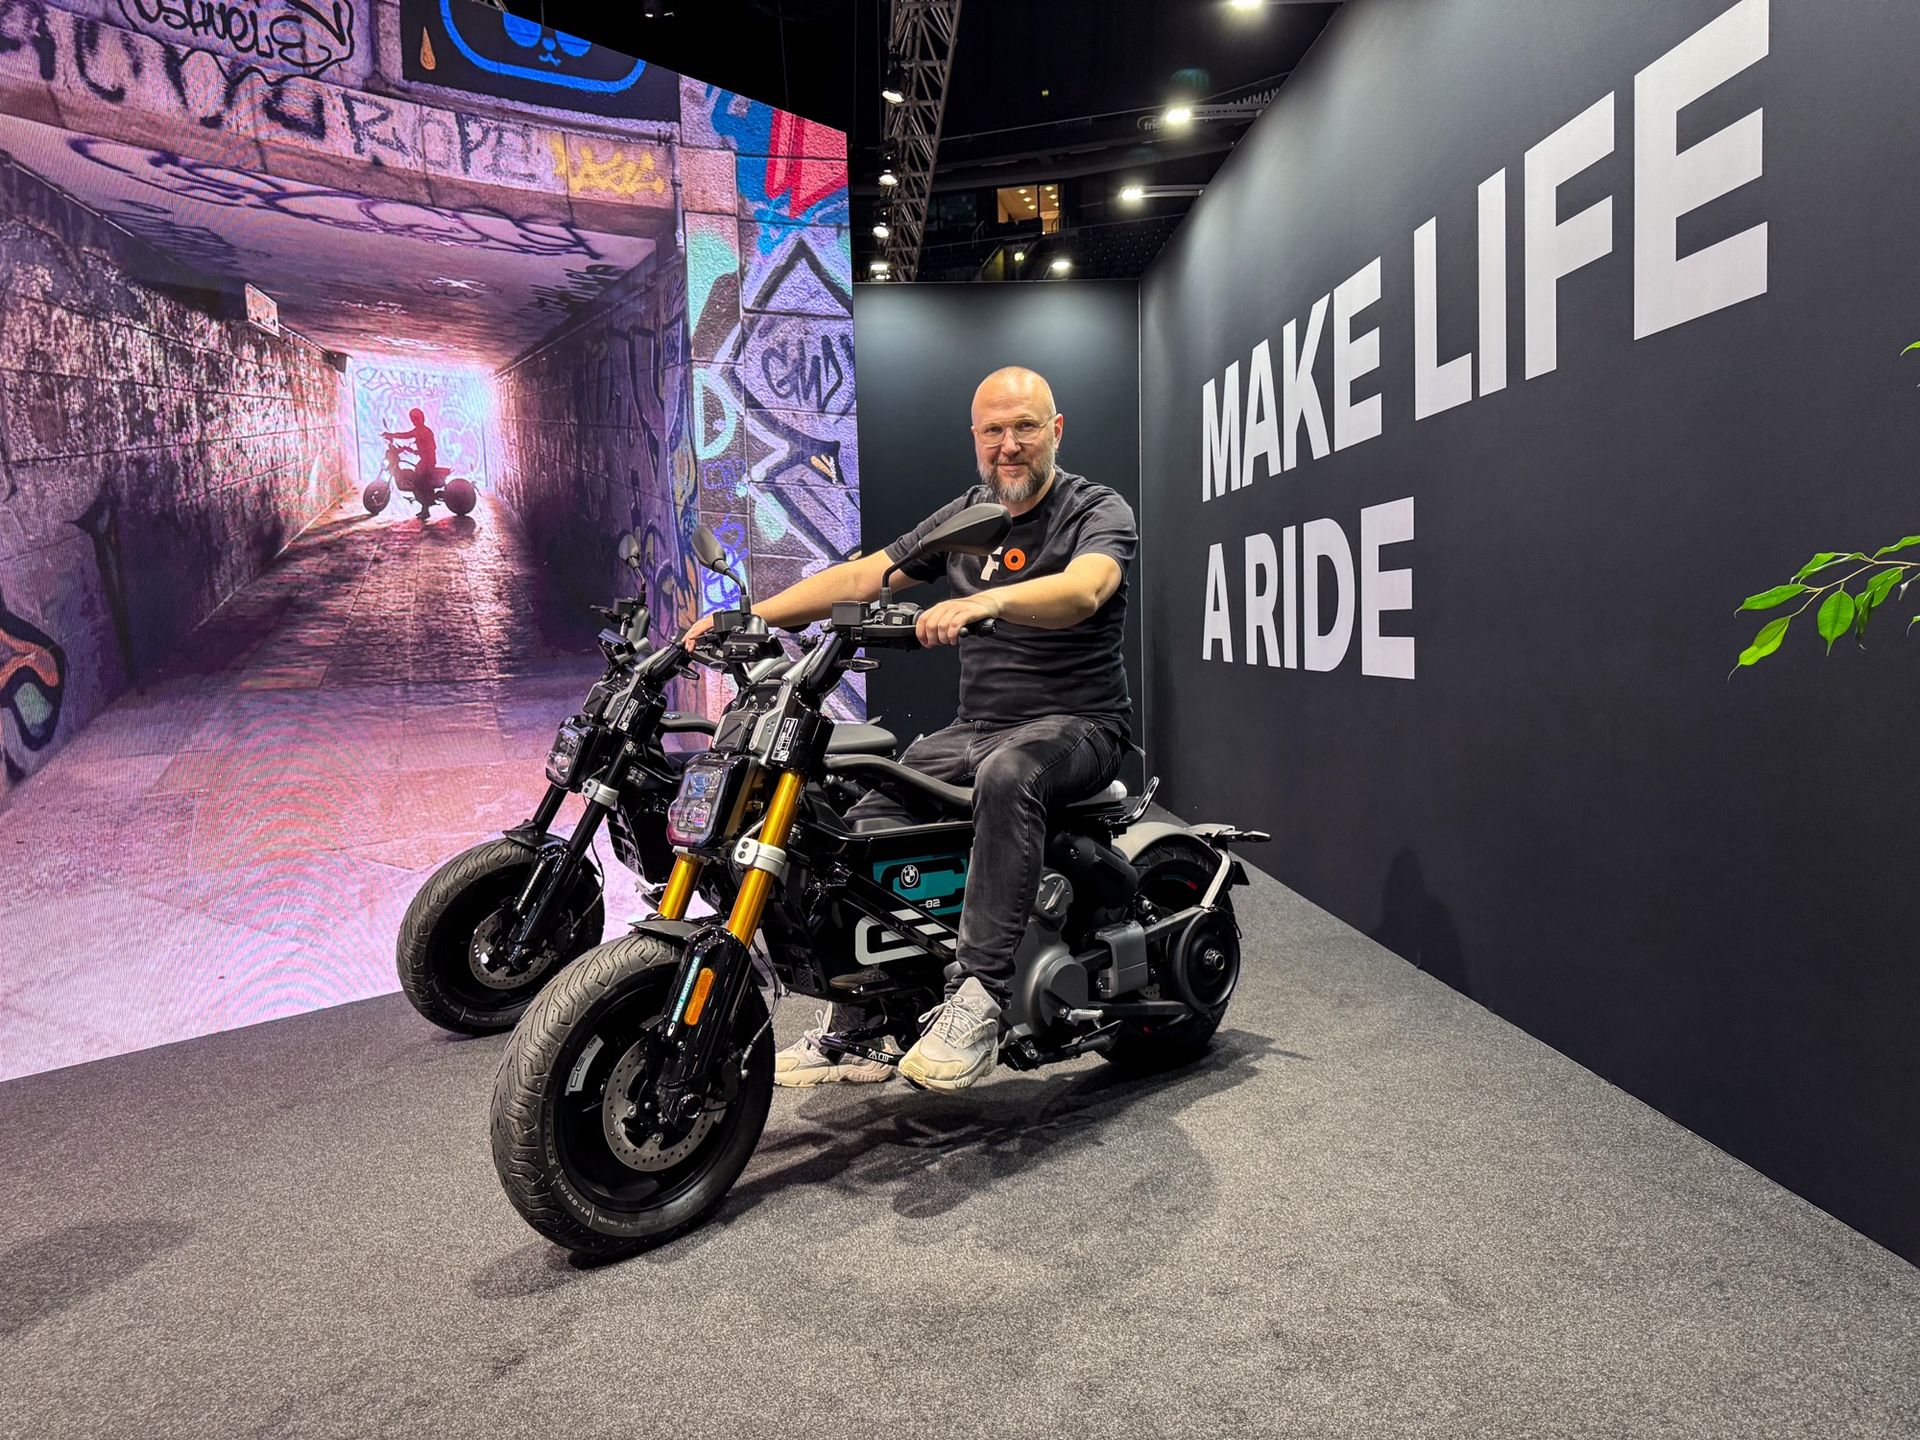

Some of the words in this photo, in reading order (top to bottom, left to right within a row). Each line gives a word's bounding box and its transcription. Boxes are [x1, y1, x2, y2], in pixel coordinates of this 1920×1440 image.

[1202, 256, 1382, 503] MAKE
[1414, 0, 1769, 420] LIFE
[1203, 543, 1233, 662] A
[1245, 497, 1414, 679] RIDE
